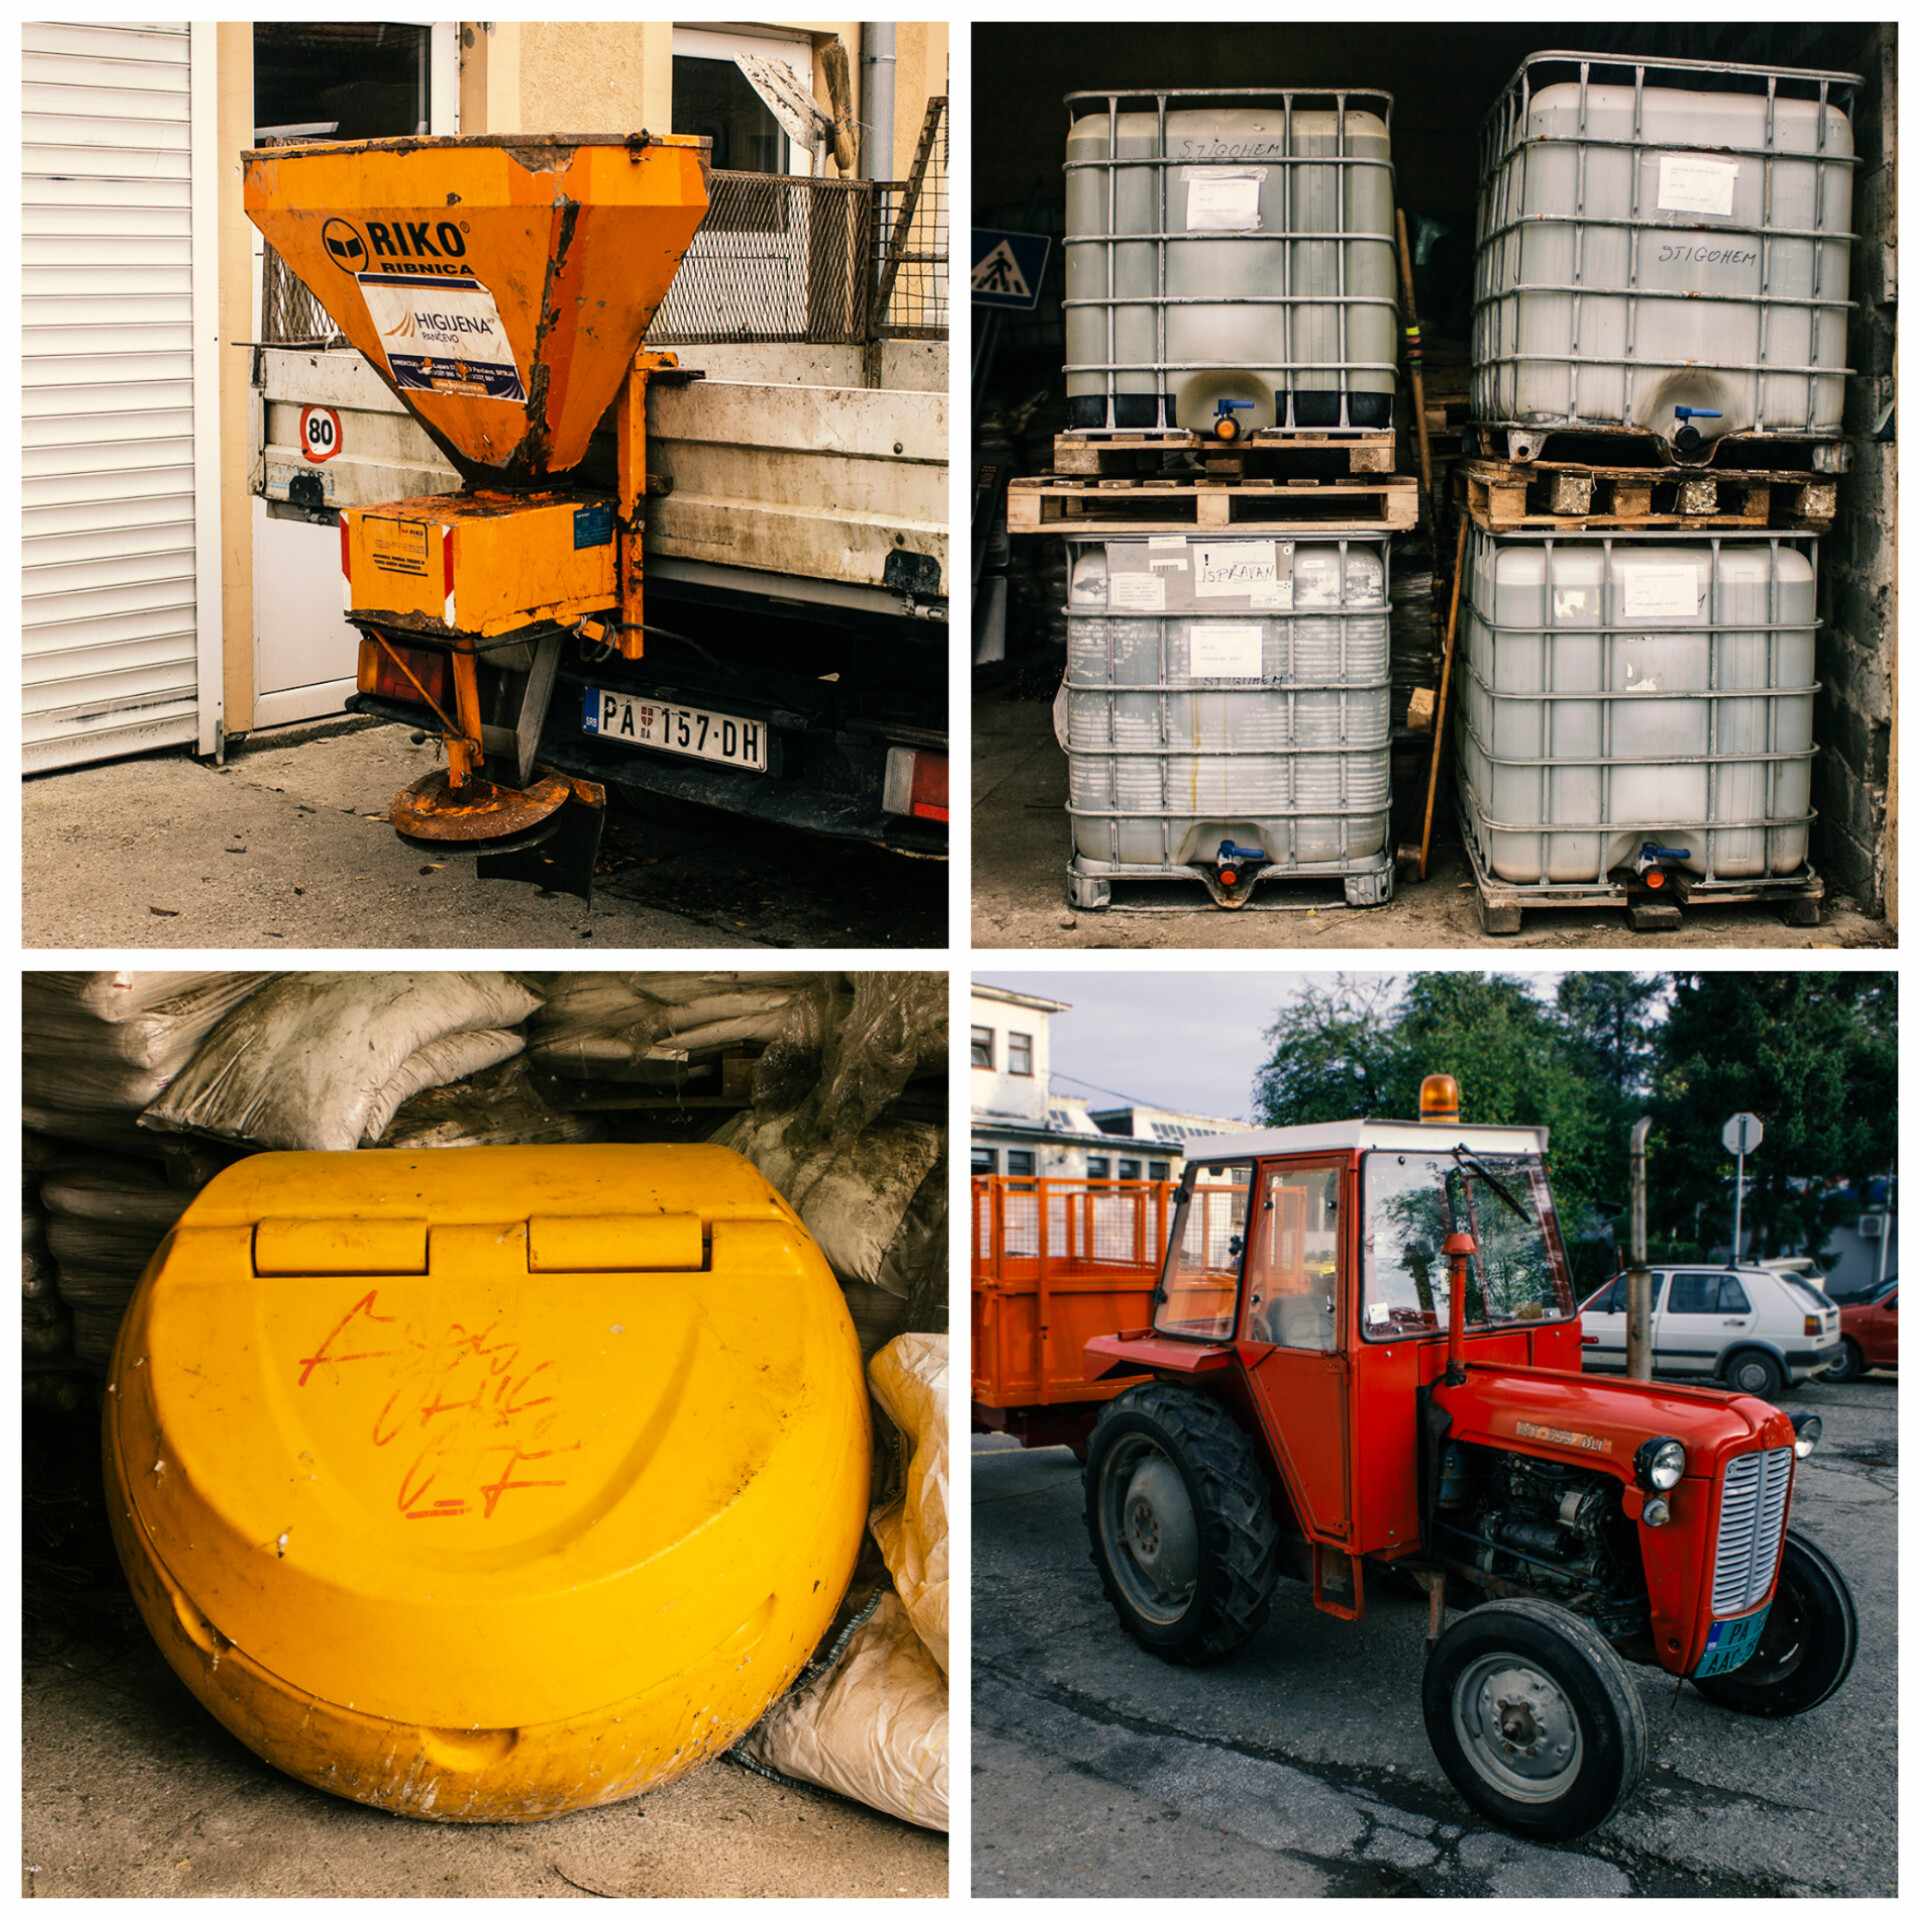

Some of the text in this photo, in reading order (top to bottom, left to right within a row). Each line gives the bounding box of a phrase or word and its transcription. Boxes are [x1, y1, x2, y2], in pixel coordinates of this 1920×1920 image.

[366, 221, 466, 258] RIKO
[1658, 245, 1757, 265] STIGOHEM
[380, 262, 475, 275] RIBNICA
[415, 312, 493, 334] HIGIJENA
[309, 418, 333, 445] 80
[603, 696, 634, 737] PA
